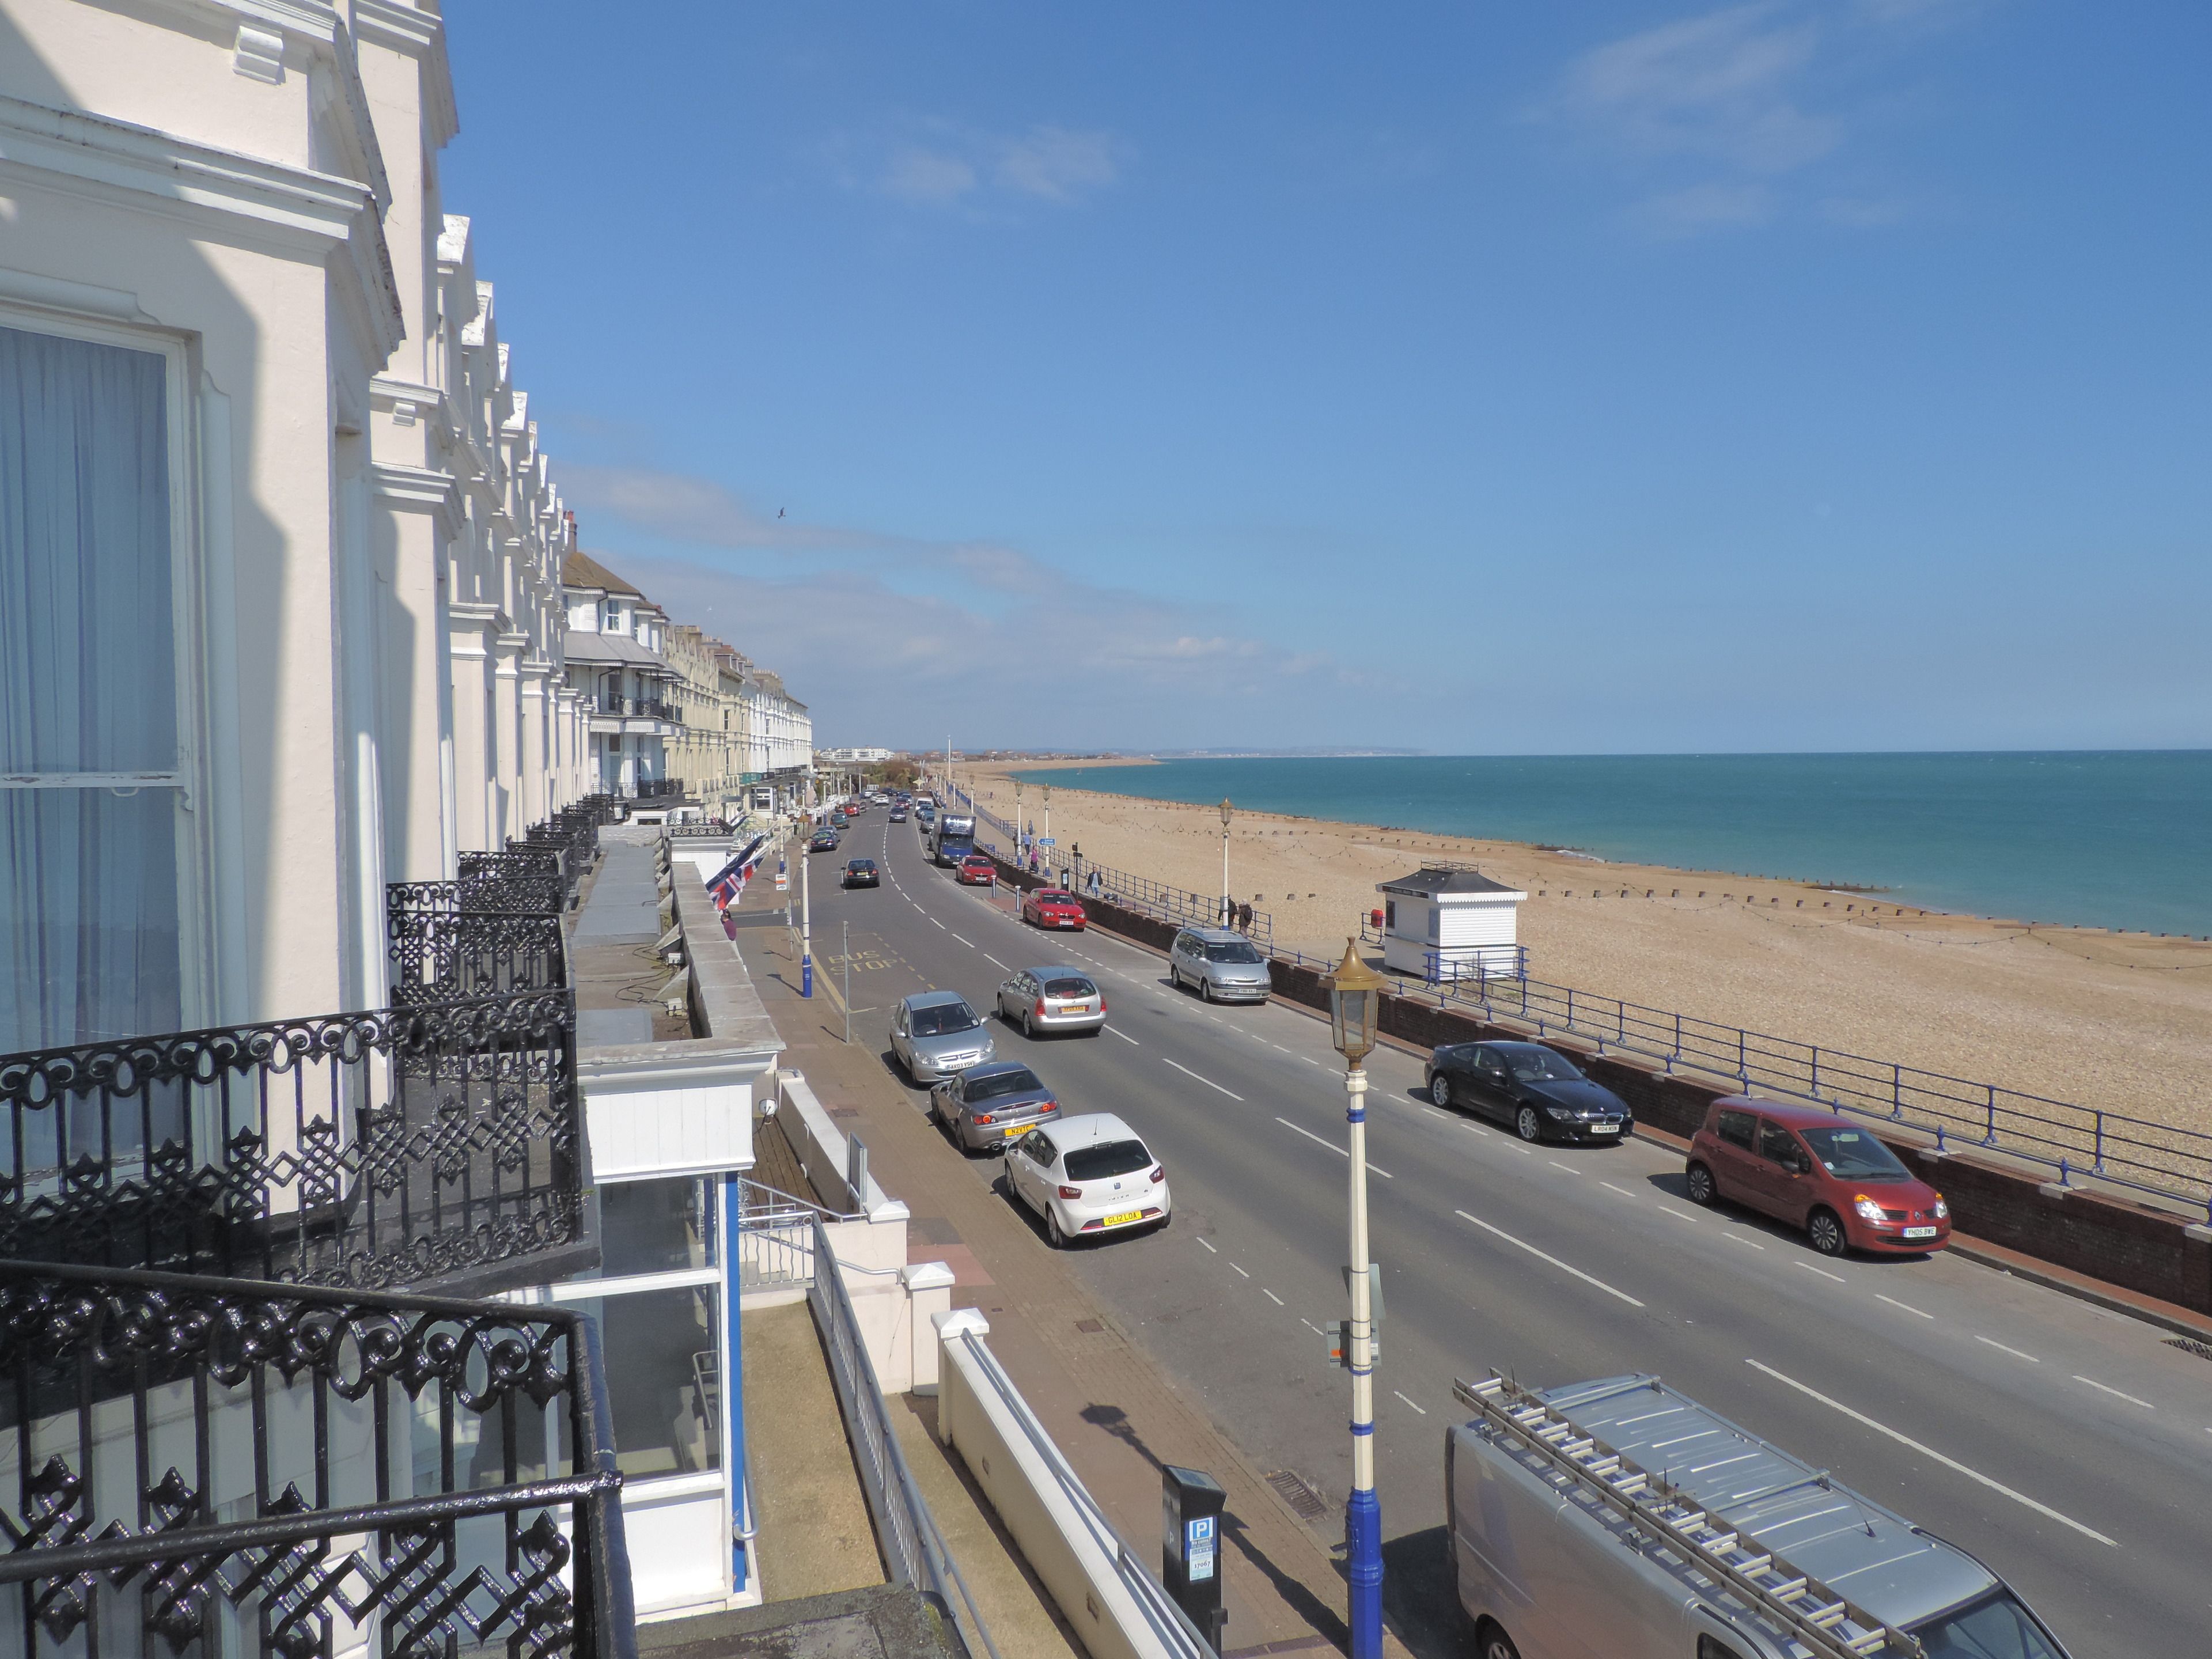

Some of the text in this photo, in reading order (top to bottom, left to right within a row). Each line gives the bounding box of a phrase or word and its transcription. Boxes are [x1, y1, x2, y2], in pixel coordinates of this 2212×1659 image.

[828, 950, 880, 964] BUS
[830, 959, 897, 975] STOP
[1108, 1212, 1137, 1224] GL12 LOA
[1196, 1522, 1207, 1537] P
[1194, 1560, 1211, 1569] 17067
